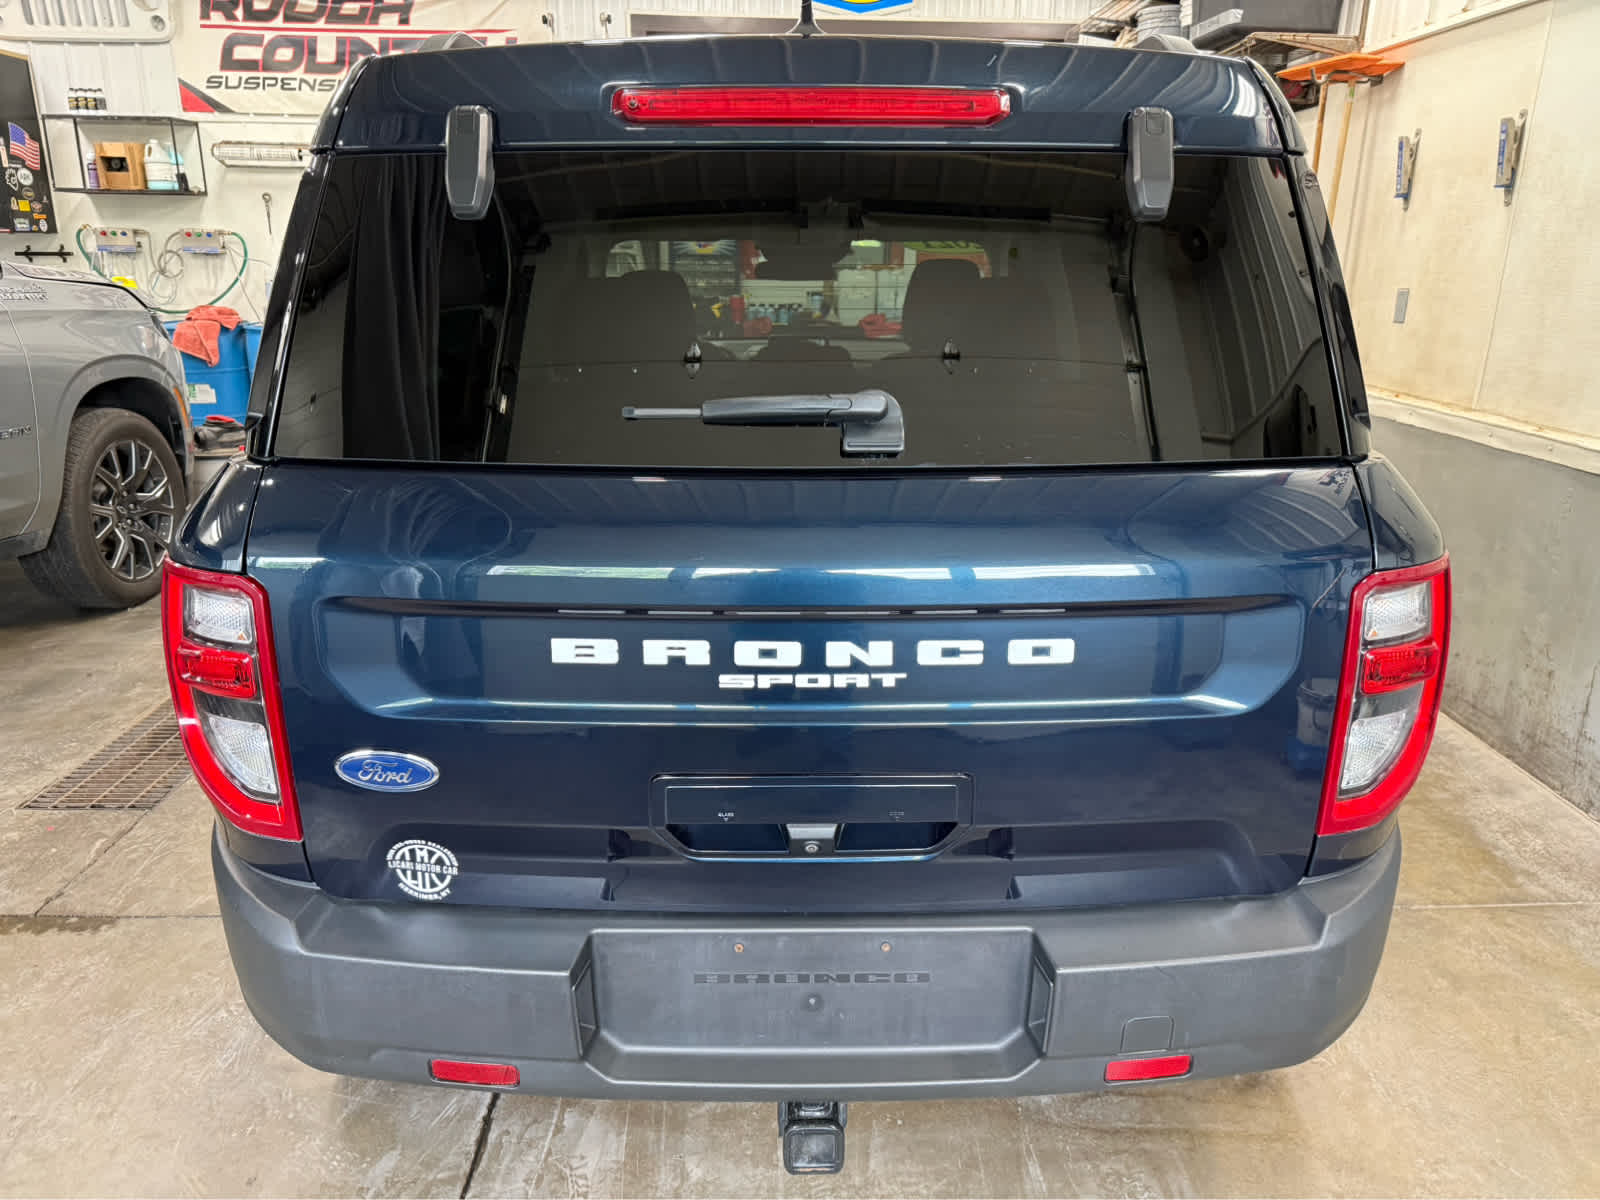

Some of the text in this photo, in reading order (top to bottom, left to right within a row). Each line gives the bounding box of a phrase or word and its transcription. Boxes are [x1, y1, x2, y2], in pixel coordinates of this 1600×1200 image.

[551, 637, 1075, 668] BRONCO
[718, 673, 908, 689] SPORT
[358, 760, 413, 783] Ford
[415, 862, 441, 874] MOTOR
[442, 865, 459, 876] CAR
[694, 973, 930, 984] BRONCO
